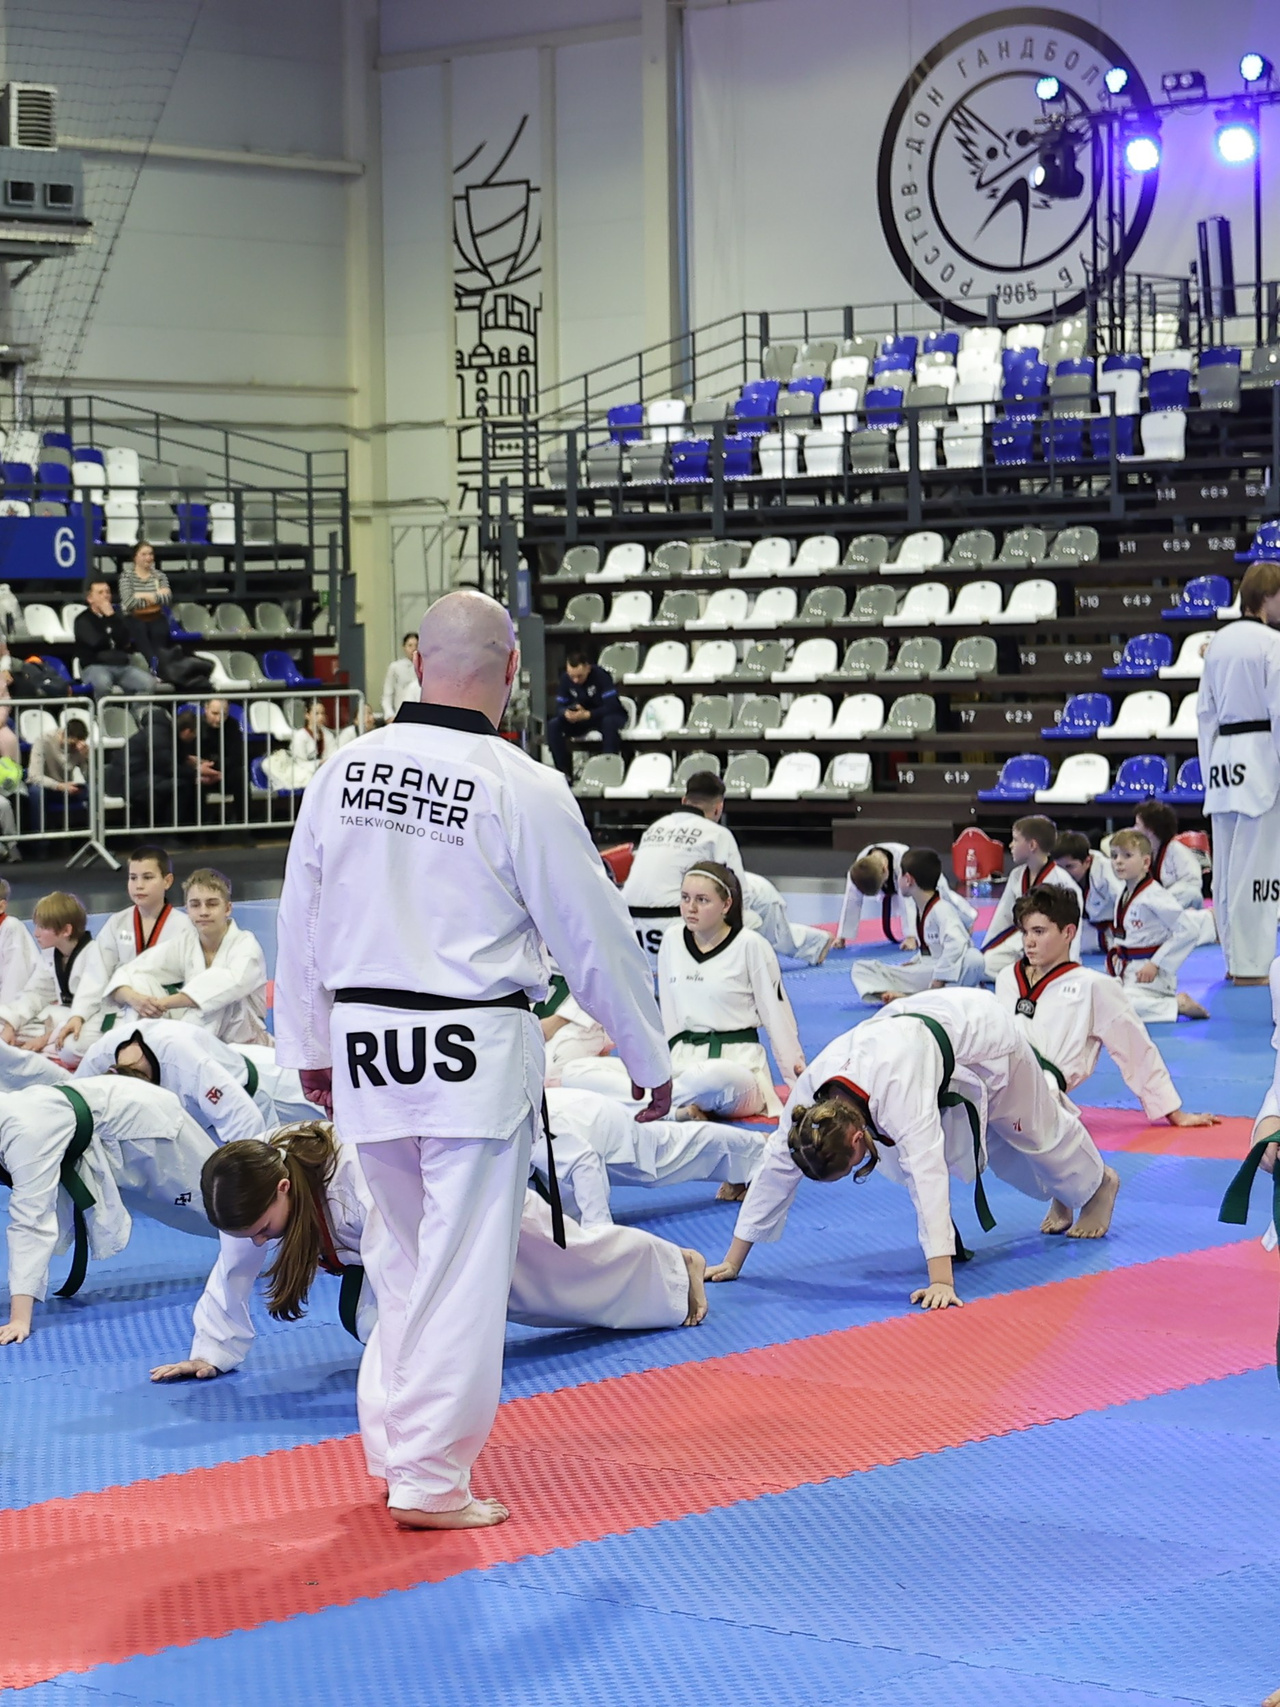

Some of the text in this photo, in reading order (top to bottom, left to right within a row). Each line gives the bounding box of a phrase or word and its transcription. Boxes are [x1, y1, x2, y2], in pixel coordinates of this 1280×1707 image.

[900, 86, 975, 297] РОСТОВ-ДОН
[995, 280, 1038, 305] 1965
[54, 526, 77, 568] 6
[1015, 709, 1024, 724] 2
[345, 761, 476, 802] GRAND
[1209, 763, 1247, 790] RUS
[341, 787, 469, 830] MASTER
[340, 815, 465, 847] TAEKWONDO CLUB
[1253, 878, 1280, 903] RUS
[346, 1023, 477, 1089] RUS
